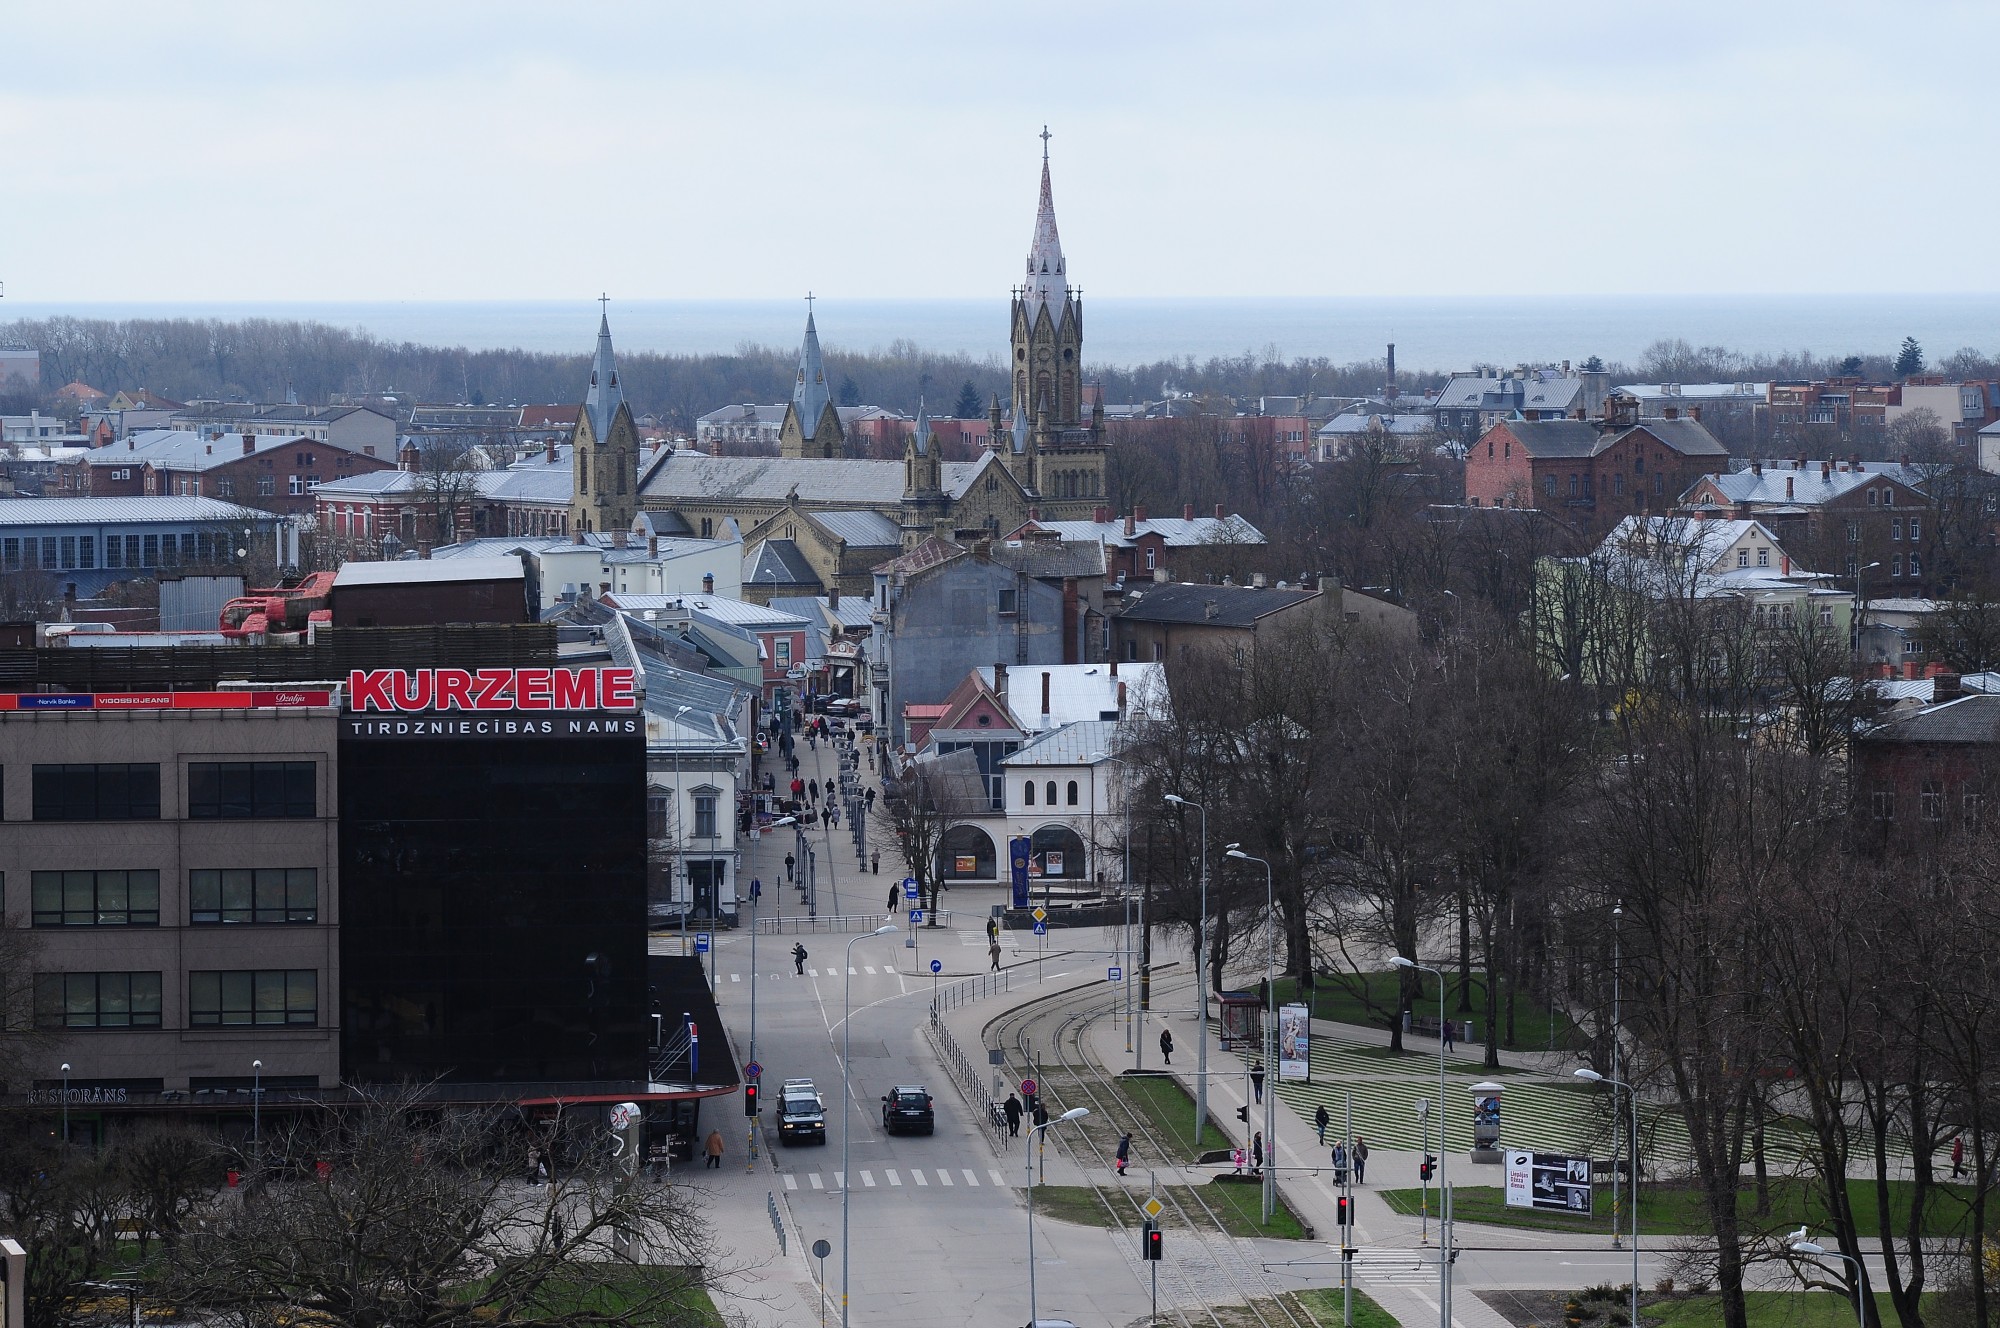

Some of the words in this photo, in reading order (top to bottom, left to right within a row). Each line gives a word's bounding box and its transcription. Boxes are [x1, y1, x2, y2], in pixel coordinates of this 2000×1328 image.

[350, 667, 637, 712] KURZEME
[351, 719, 553, 735] TIRDZNIECĪBAS
[569, 720, 636, 734] NAMS
